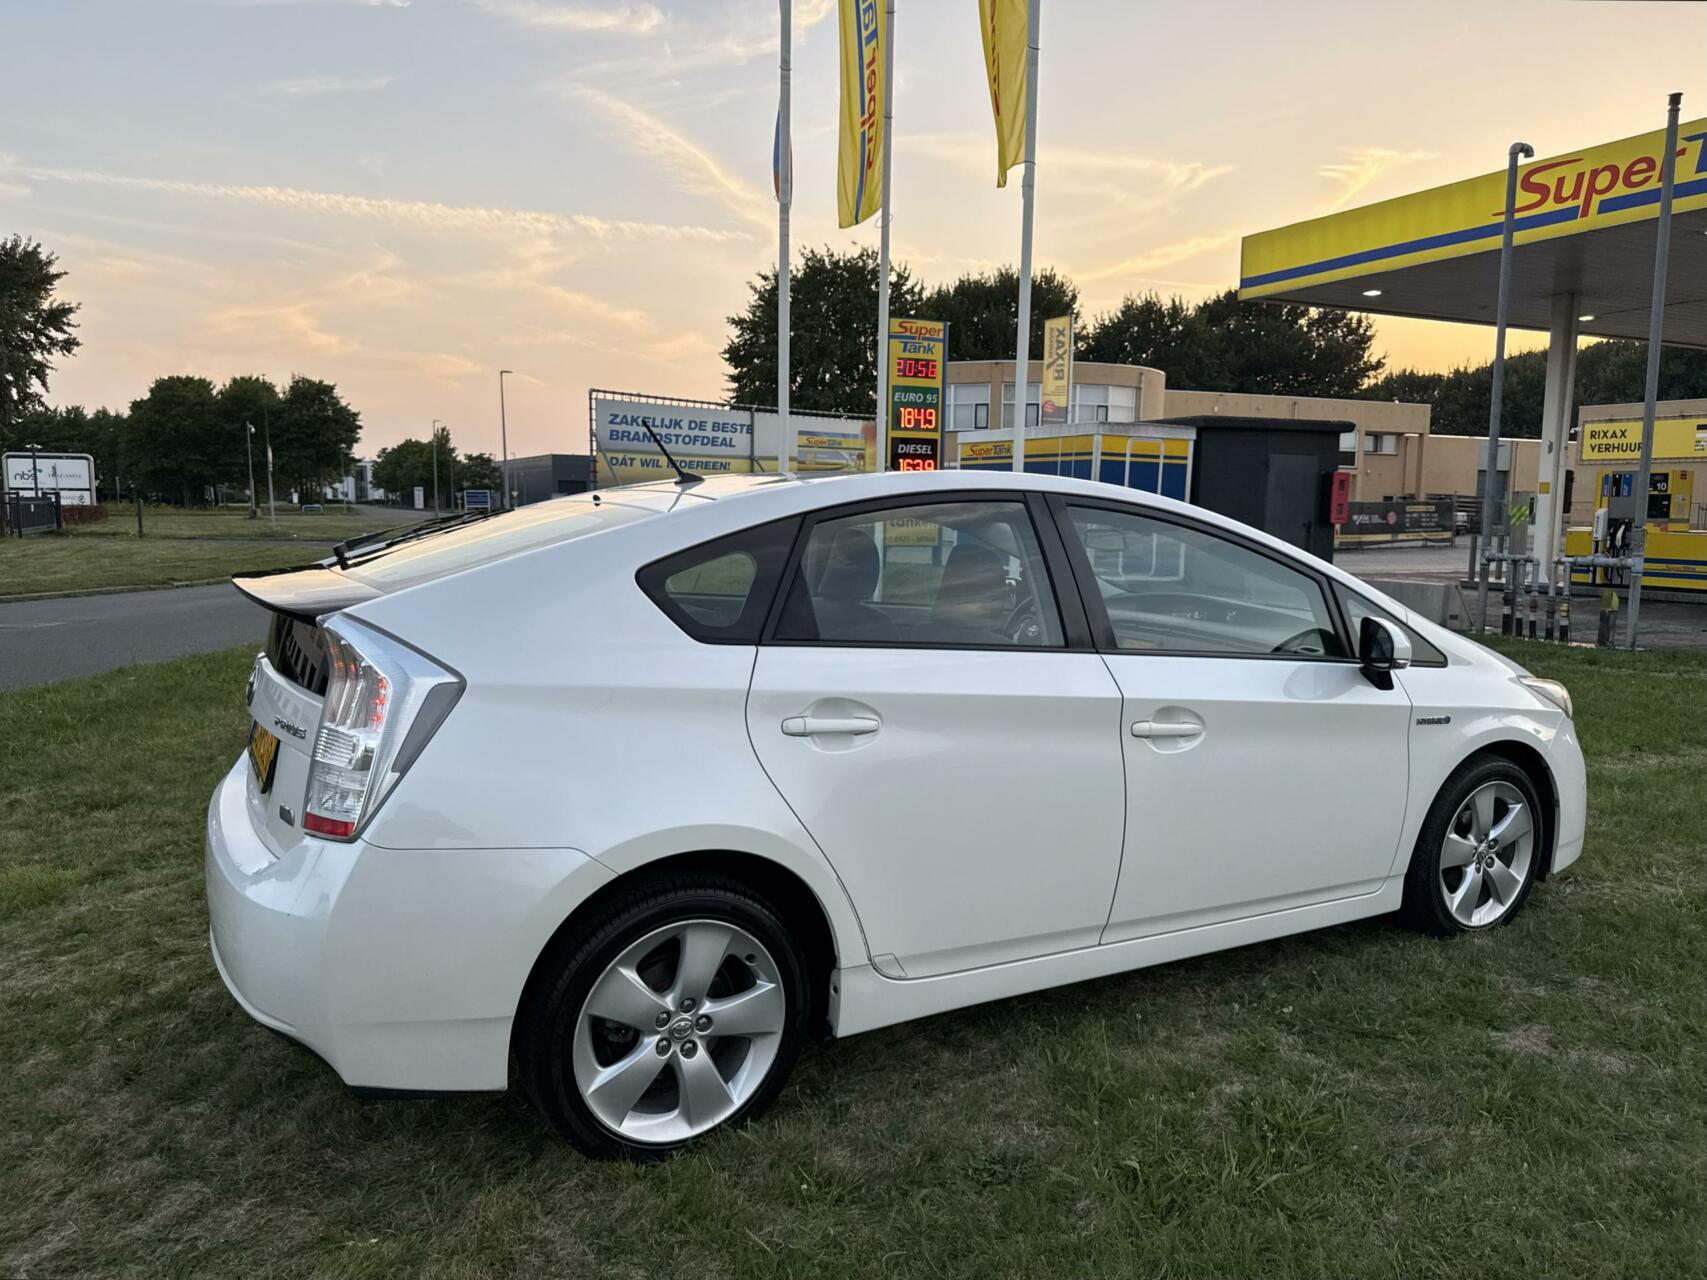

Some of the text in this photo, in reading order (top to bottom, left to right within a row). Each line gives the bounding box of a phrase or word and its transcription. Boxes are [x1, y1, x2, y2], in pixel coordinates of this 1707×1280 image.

[889, 320, 943, 341] Super
[898, 341, 936, 355] Tank
[896, 359, 937, 378] 20:56
[894, 392, 938, 404] EURO 95
[608, 413, 752, 434] ZAKELIJK DE BESTE
[609, 429, 736, 448] BRANDSTOFDEAL
[1590, 429, 1628, 440] RIXAX
[897, 444, 933, 454] DIESEL
[609, 455, 636, 467] DÁT
[640, 458, 663, 468] WIL
[1656, 482, 1667, 491] 10
